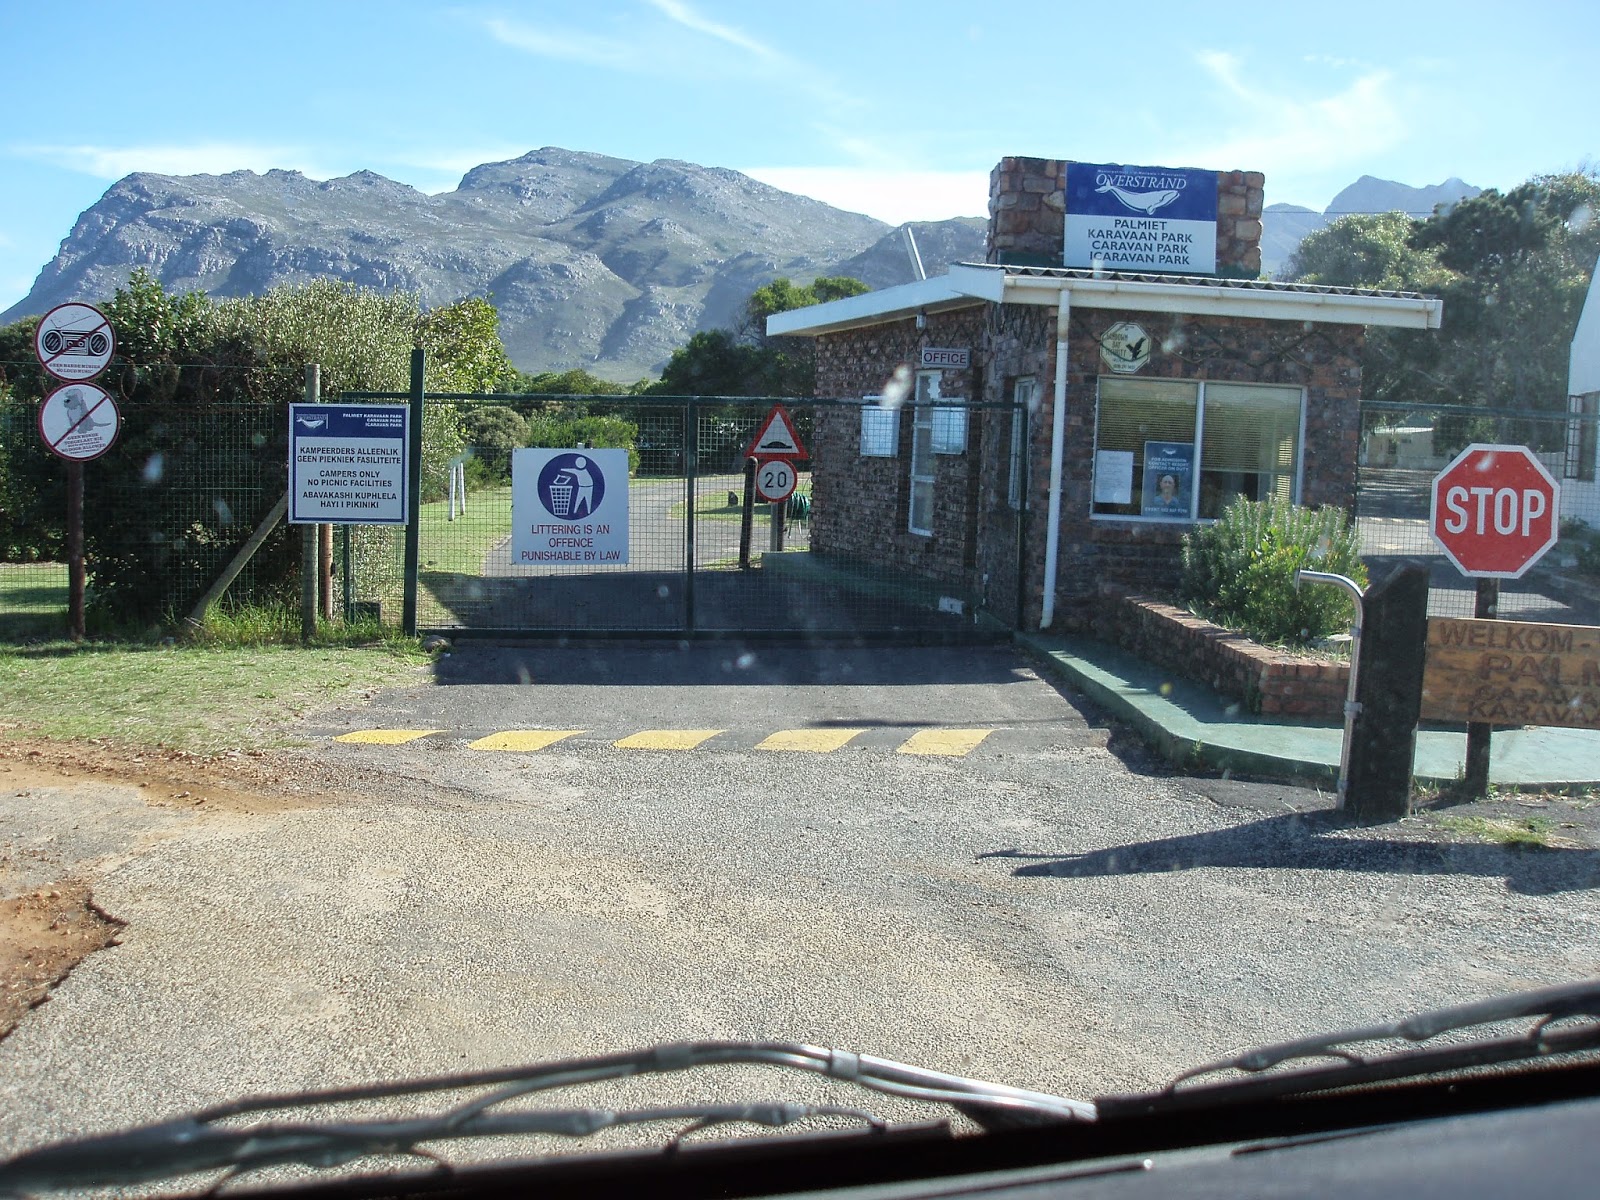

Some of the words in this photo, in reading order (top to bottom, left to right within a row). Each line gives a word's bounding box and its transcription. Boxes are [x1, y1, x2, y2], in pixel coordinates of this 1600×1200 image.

[1095, 173, 1187, 190] OVERSTRAND
[1114, 219, 1167, 230] PALMIET
[1088, 229, 1157, 241] KARAVAAN
[1161, 233, 1193, 243] PARK
[1092, 241, 1153, 252] CARAVAN
[1157, 244, 1188, 254] PARK
[1090, 251, 1154, 263] ICARAVAN
[1158, 254, 1190, 265] PARK
[923, 352, 967, 363] OFFICE
[300, 447, 355, 455] KAMPEERDERS
[765, 471, 787, 488] 20
[303, 491, 353, 499] ABAVAKASHI
[1444, 486, 1546, 537] STOP
[531, 524, 580, 534] LITTERING
[583, 524, 593, 534] IS
[596, 524, 610, 534] AN
[549, 538, 593, 548] OFFENCE
[521, 551, 581, 560] PUNISHABLE
[584, 551, 596, 560] BY
[600, 551, 620, 560] LAW
